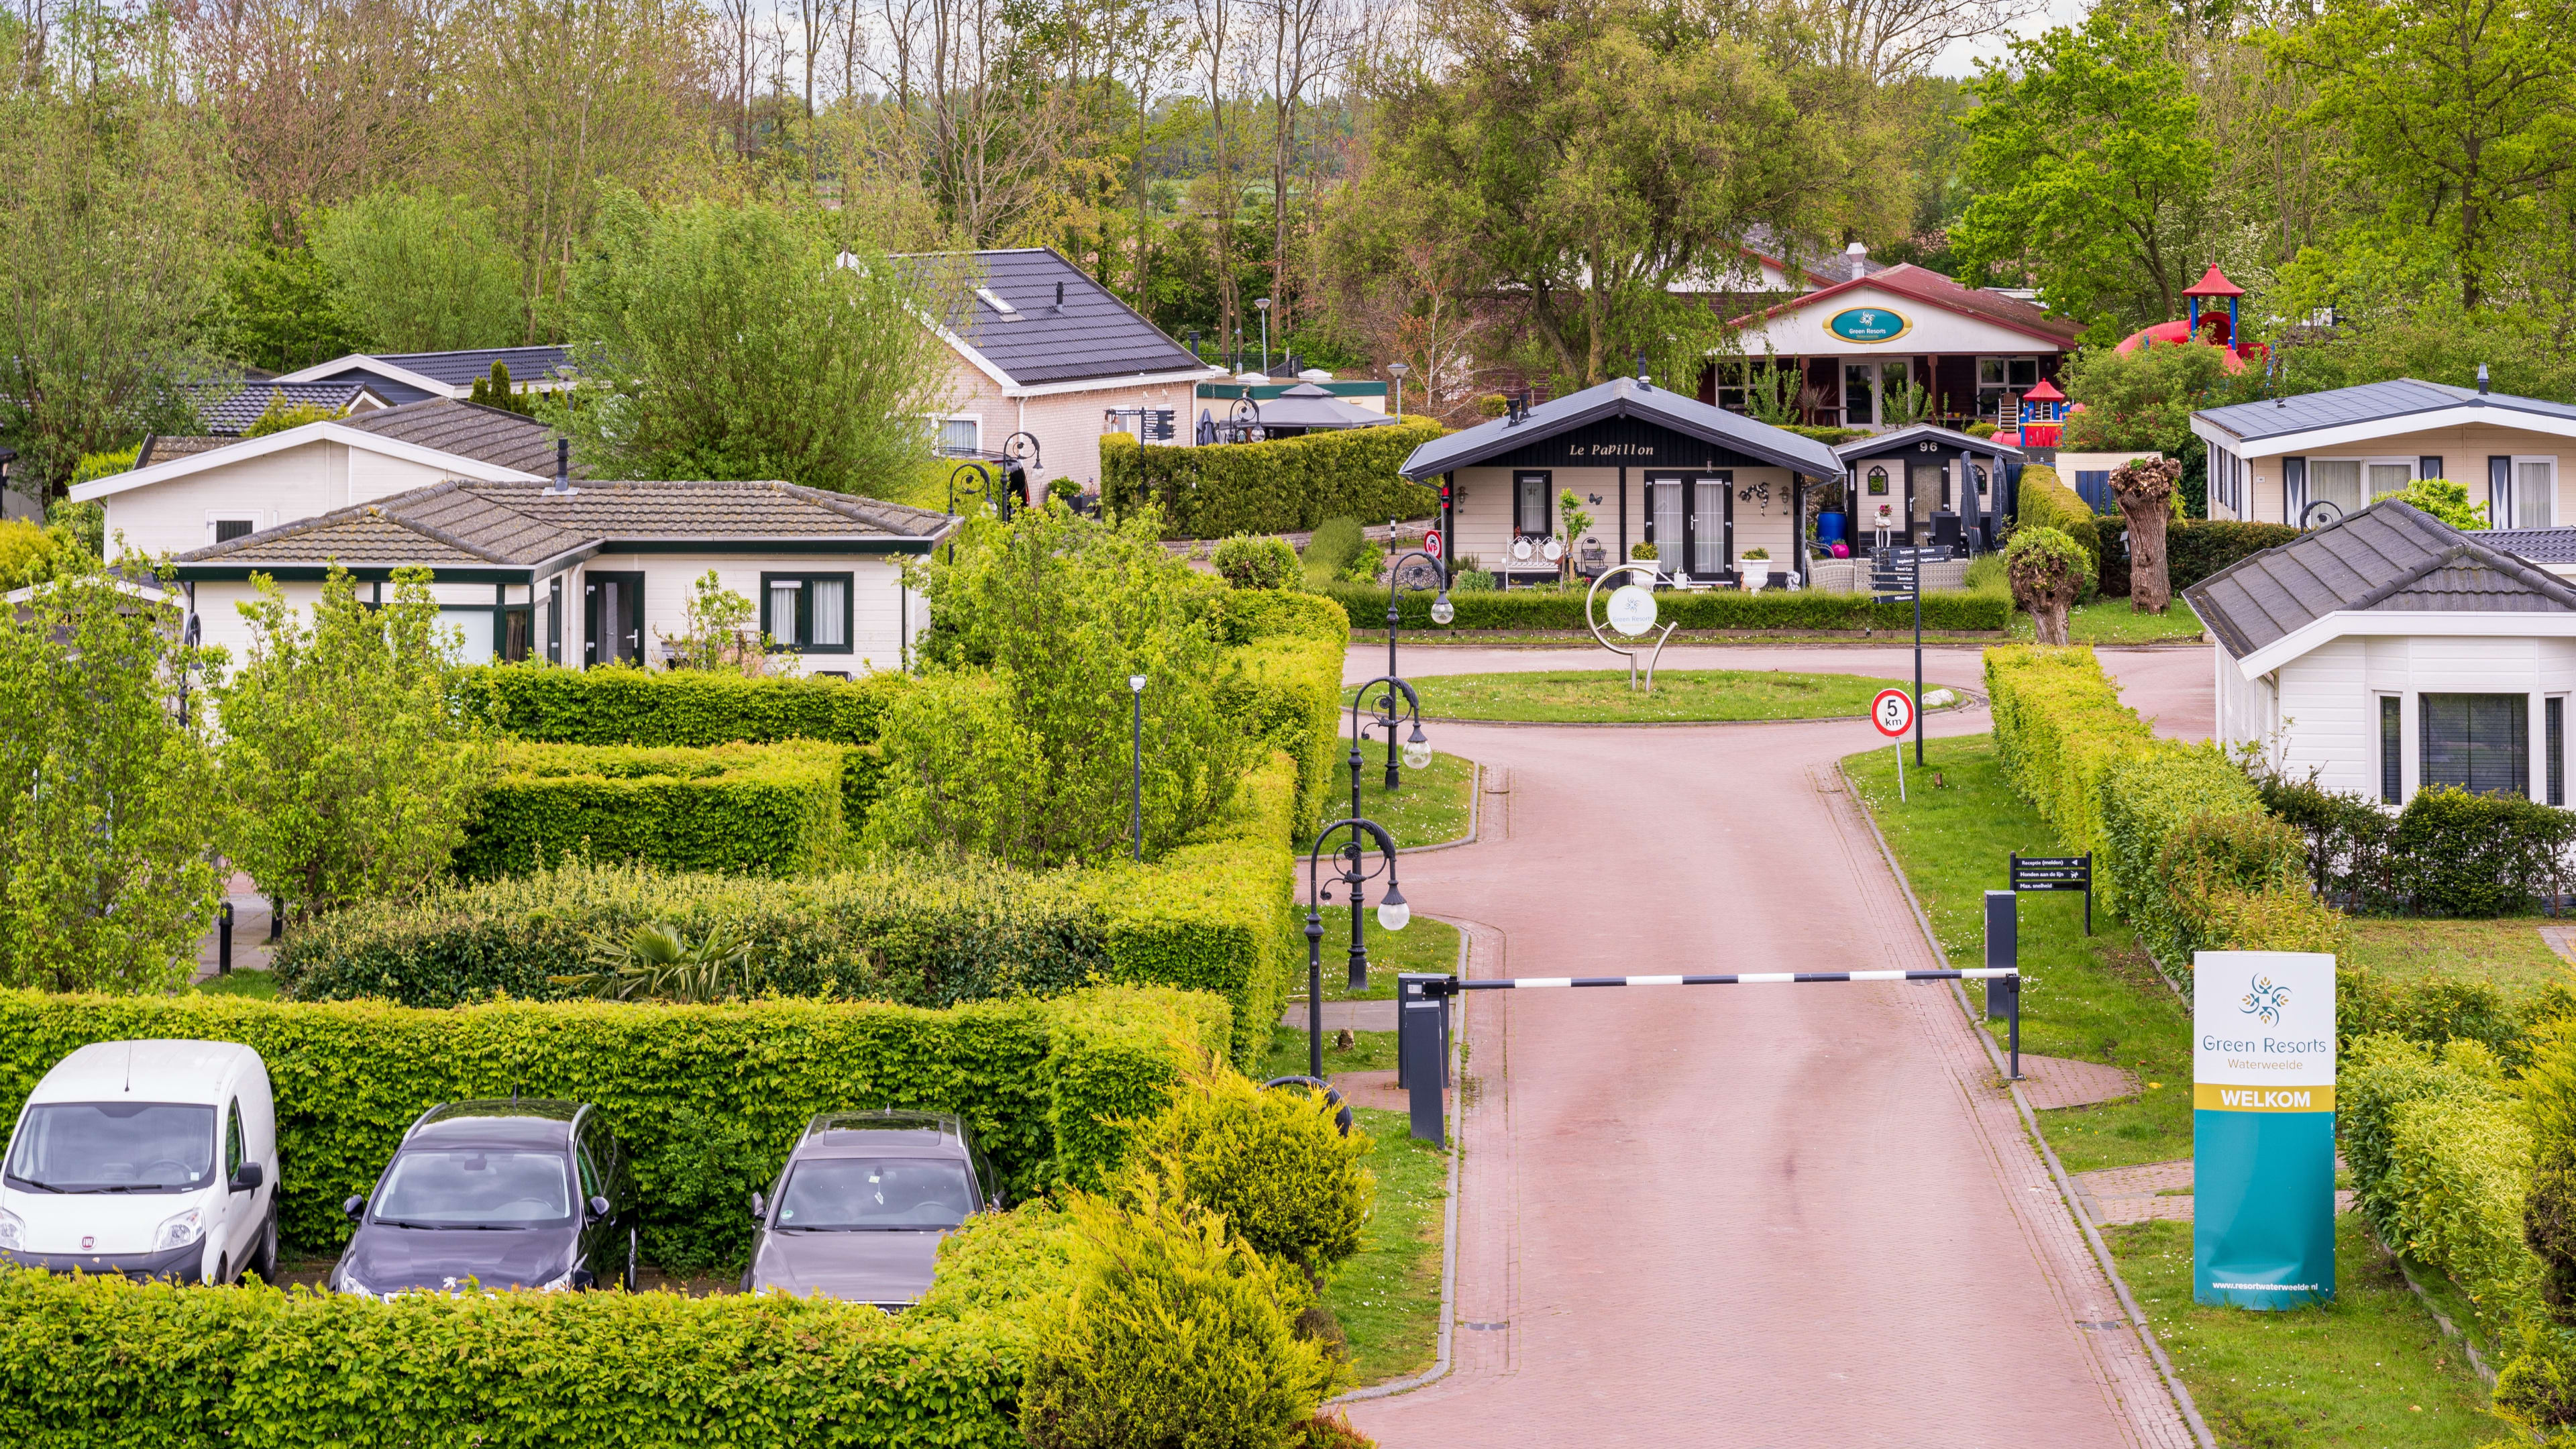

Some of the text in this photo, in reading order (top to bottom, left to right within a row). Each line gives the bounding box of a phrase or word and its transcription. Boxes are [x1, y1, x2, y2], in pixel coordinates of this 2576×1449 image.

[1569, 445, 1585, 455] Le
[1919, 441, 1938, 452] 96
[1887, 699, 1898, 717] 5
[1885, 718, 1902, 726] km
[2203, 1035, 2326, 1053] Green Resorts
[2228, 1058, 2303, 1070] Waterweelde
[2220, 1089, 2310, 1108] WELKOM
[2212, 1281, 2318, 1291] www.resortwaterweeldenl
